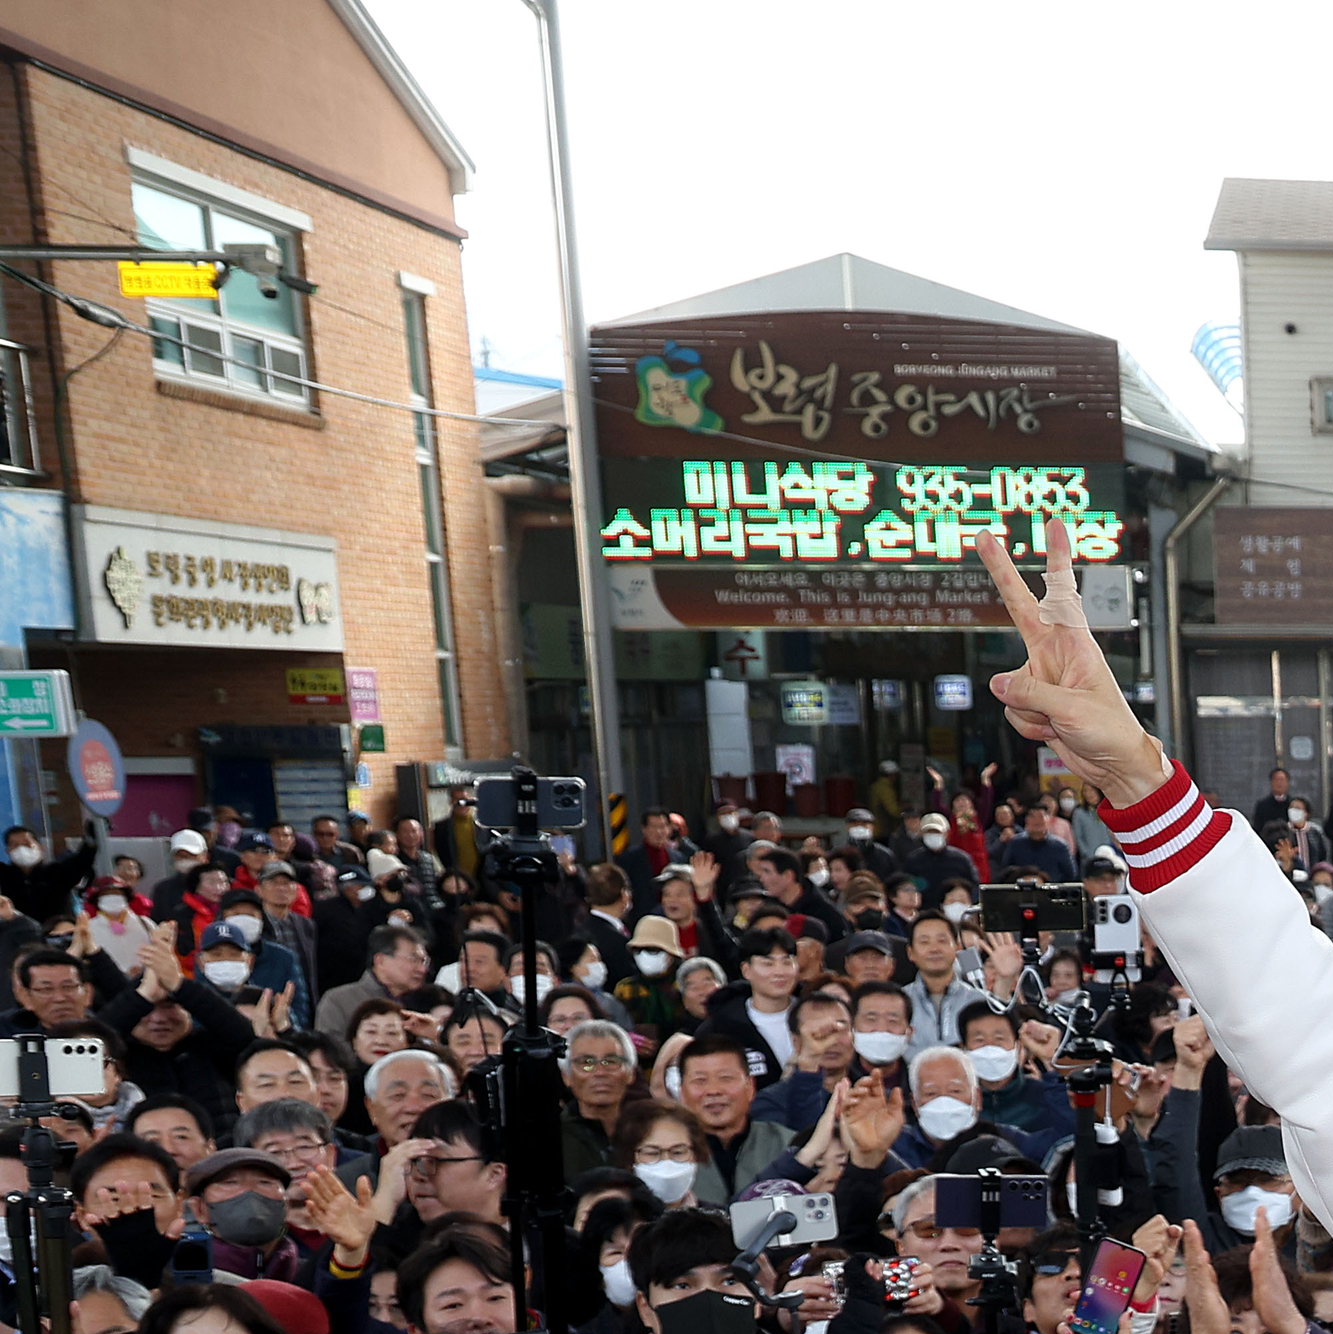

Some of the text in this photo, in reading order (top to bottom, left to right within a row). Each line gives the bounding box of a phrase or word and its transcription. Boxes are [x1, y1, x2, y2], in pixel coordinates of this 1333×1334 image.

[893, 364, 952, 378] BORYEONG
[1010, 365, 1057, 379] MARKET
[682, 460, 1092, 516] 미니식당 935-0853
[1239, 534, 1301, 555] 생활공예
[821, 573, 866, 587] 이곳은
[874, 573, 931, 588] 중앙시장
[714, 589, 990, 606] Welcome. This is Jung-ang Market
